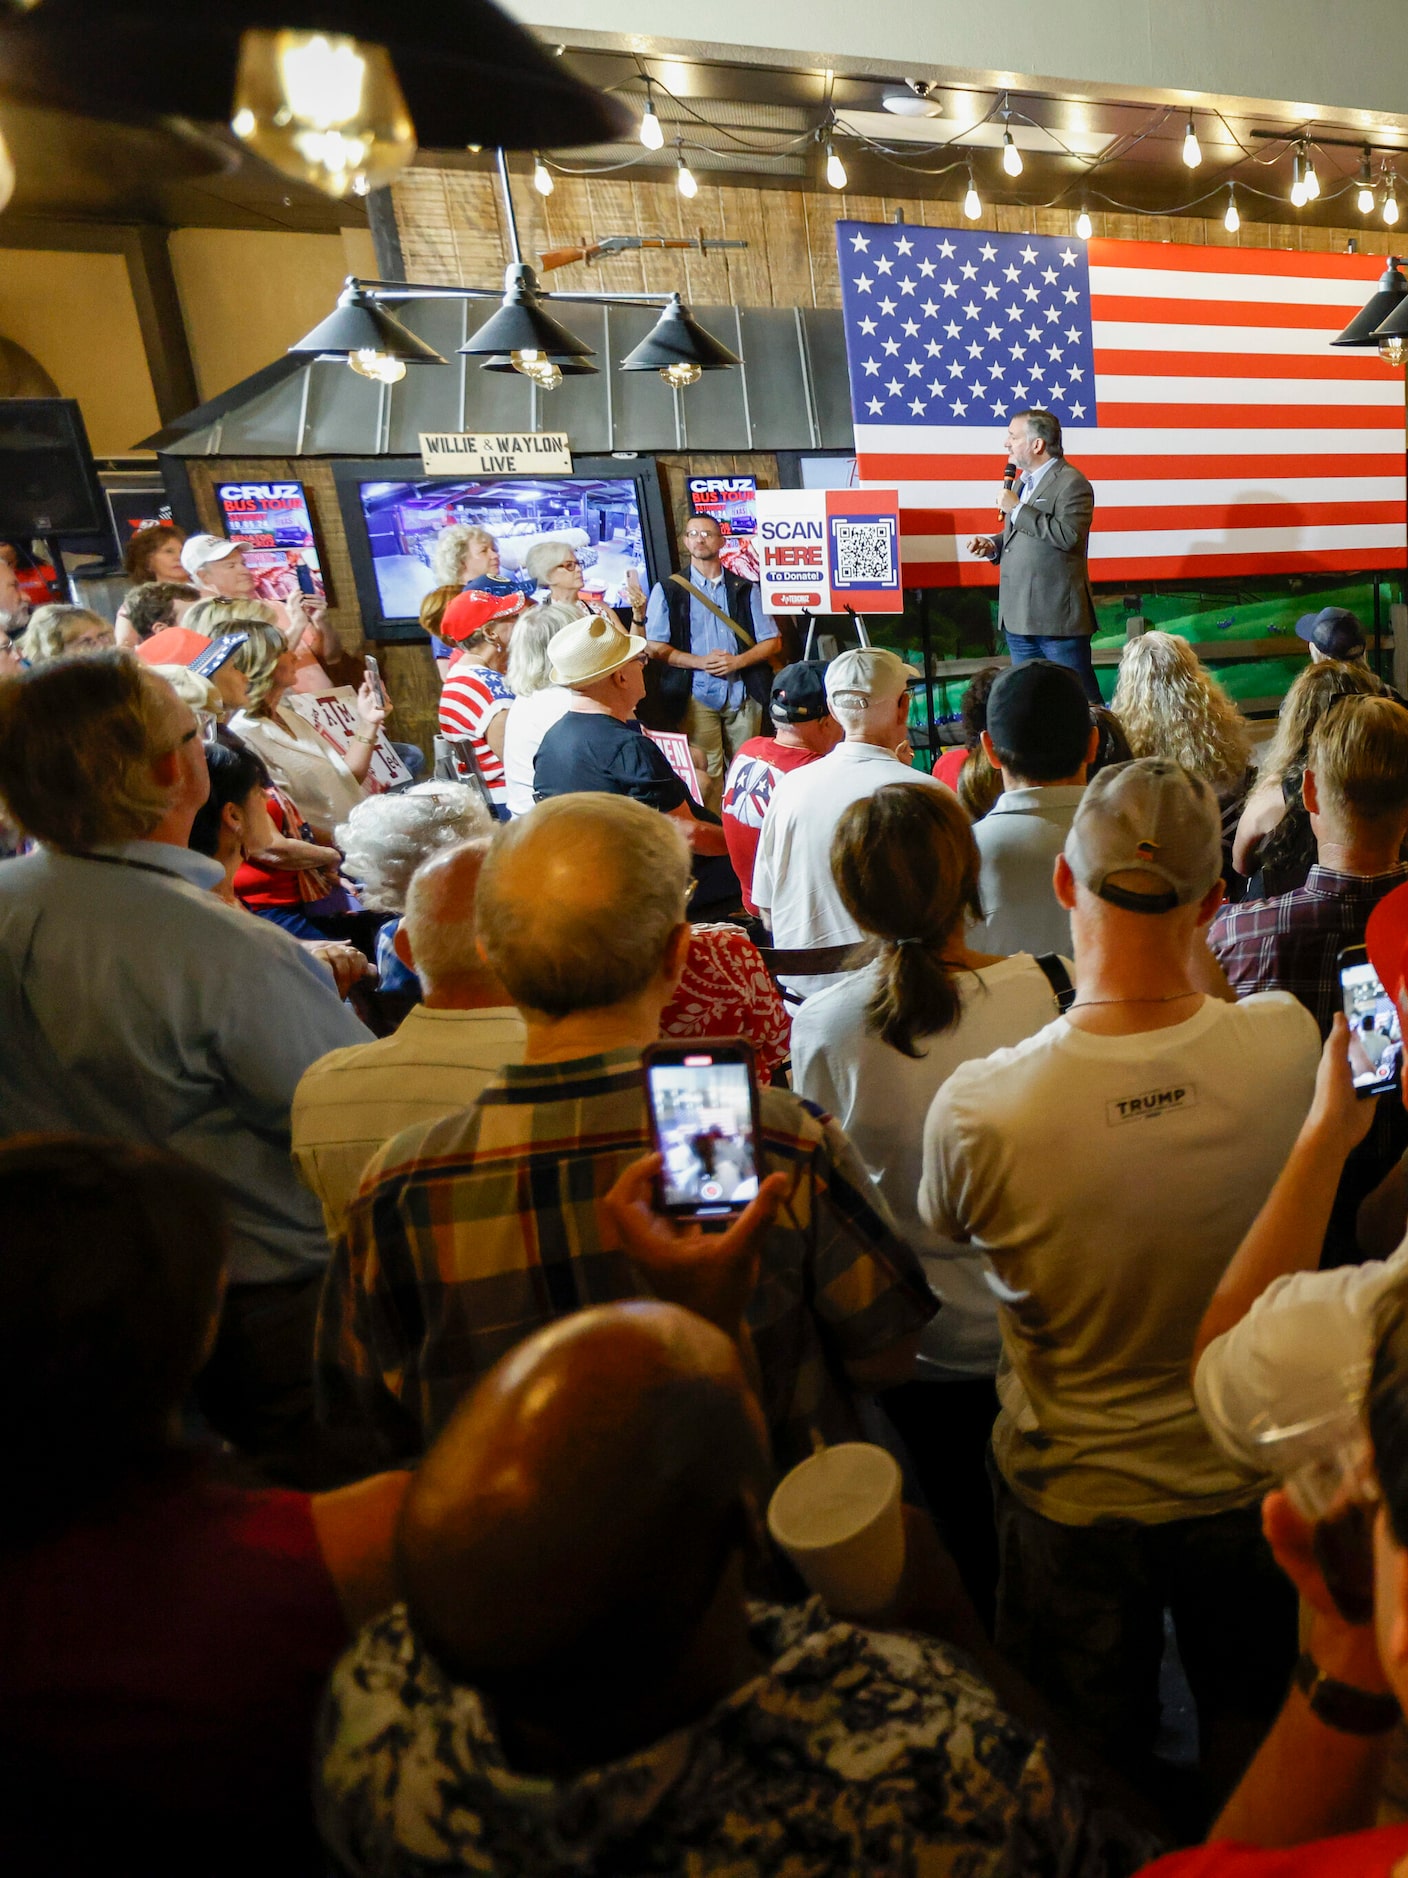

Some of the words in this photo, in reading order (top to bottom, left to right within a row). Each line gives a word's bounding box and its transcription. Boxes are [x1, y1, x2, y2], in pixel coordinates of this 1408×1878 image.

[425, 437, 478, 453] WILLIE
[483, 439, 494, 451] &
[496, 437, 563, 453] WAYLON
[480, 456, 517, 472] LIVE
[220, 485, 300, 500] CRUZ
[690, 479, 753, 493] CRUZ
[691, 492, 719, 502] BUS
[722, 491, 755, 501] TOUR
[223, 500, 257, 512] BUS
[260, 498, 304, 511] TOUR
[762, 521, 823, 540] SCAN
[764, 546, 823, 566] HERE
[770, 572, 781, 580] To
[784, 571, 820, 580] Donate!
[1116, 1089, 1185, 1114] TRUMP
